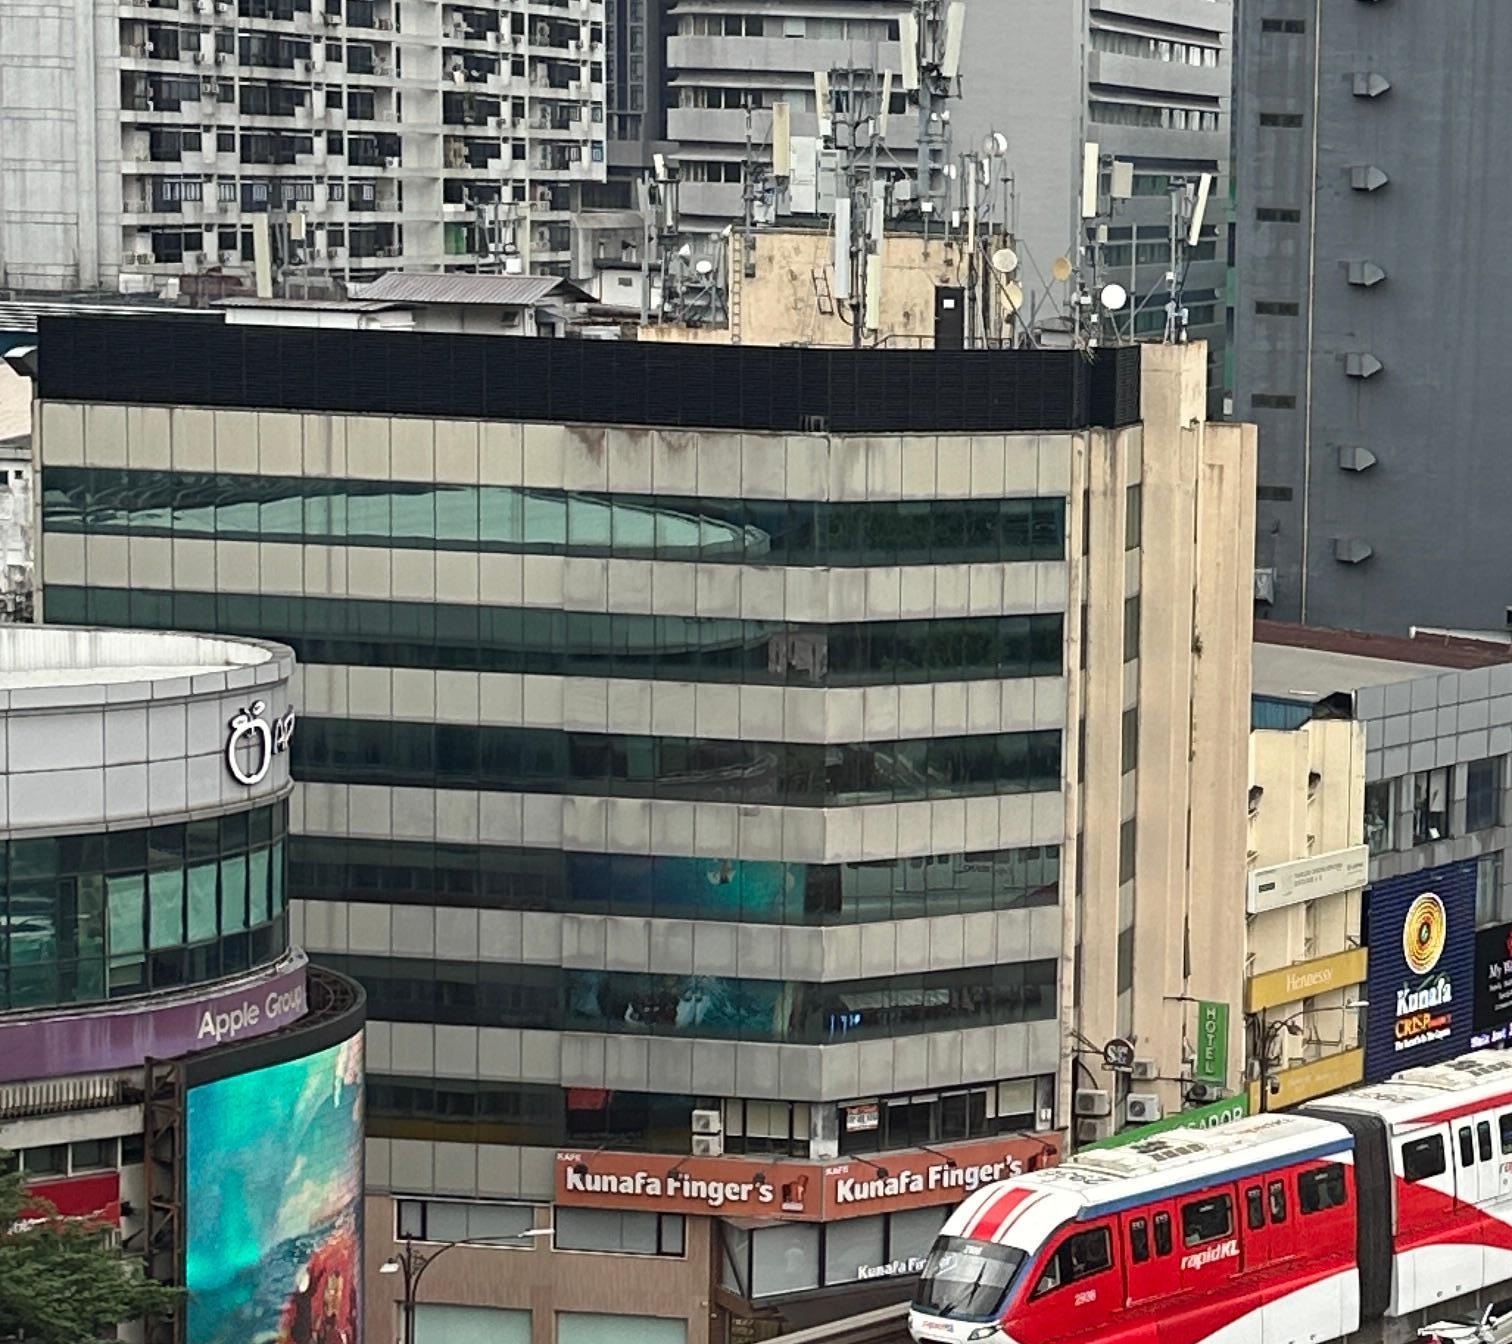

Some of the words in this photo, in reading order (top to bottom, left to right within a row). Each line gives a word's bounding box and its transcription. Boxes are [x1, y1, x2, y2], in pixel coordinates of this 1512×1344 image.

[198, 1001, 260, 1042] Apple
[264, 985, 303, 1020] Group
[1396, 977, 1453, 1017] Kunafa
[1205, 1007, 1218, 1074] HOTEL
[566, 1166, 662, 1196] Kunafa
[836, 1169, 924, 1204] Kunafa
[928, 1154, 1023, 1192] Finger's
[857, 1258, 906, 1280] Kunafa
[1180, 1239, 1240, 1271] rapidKL
